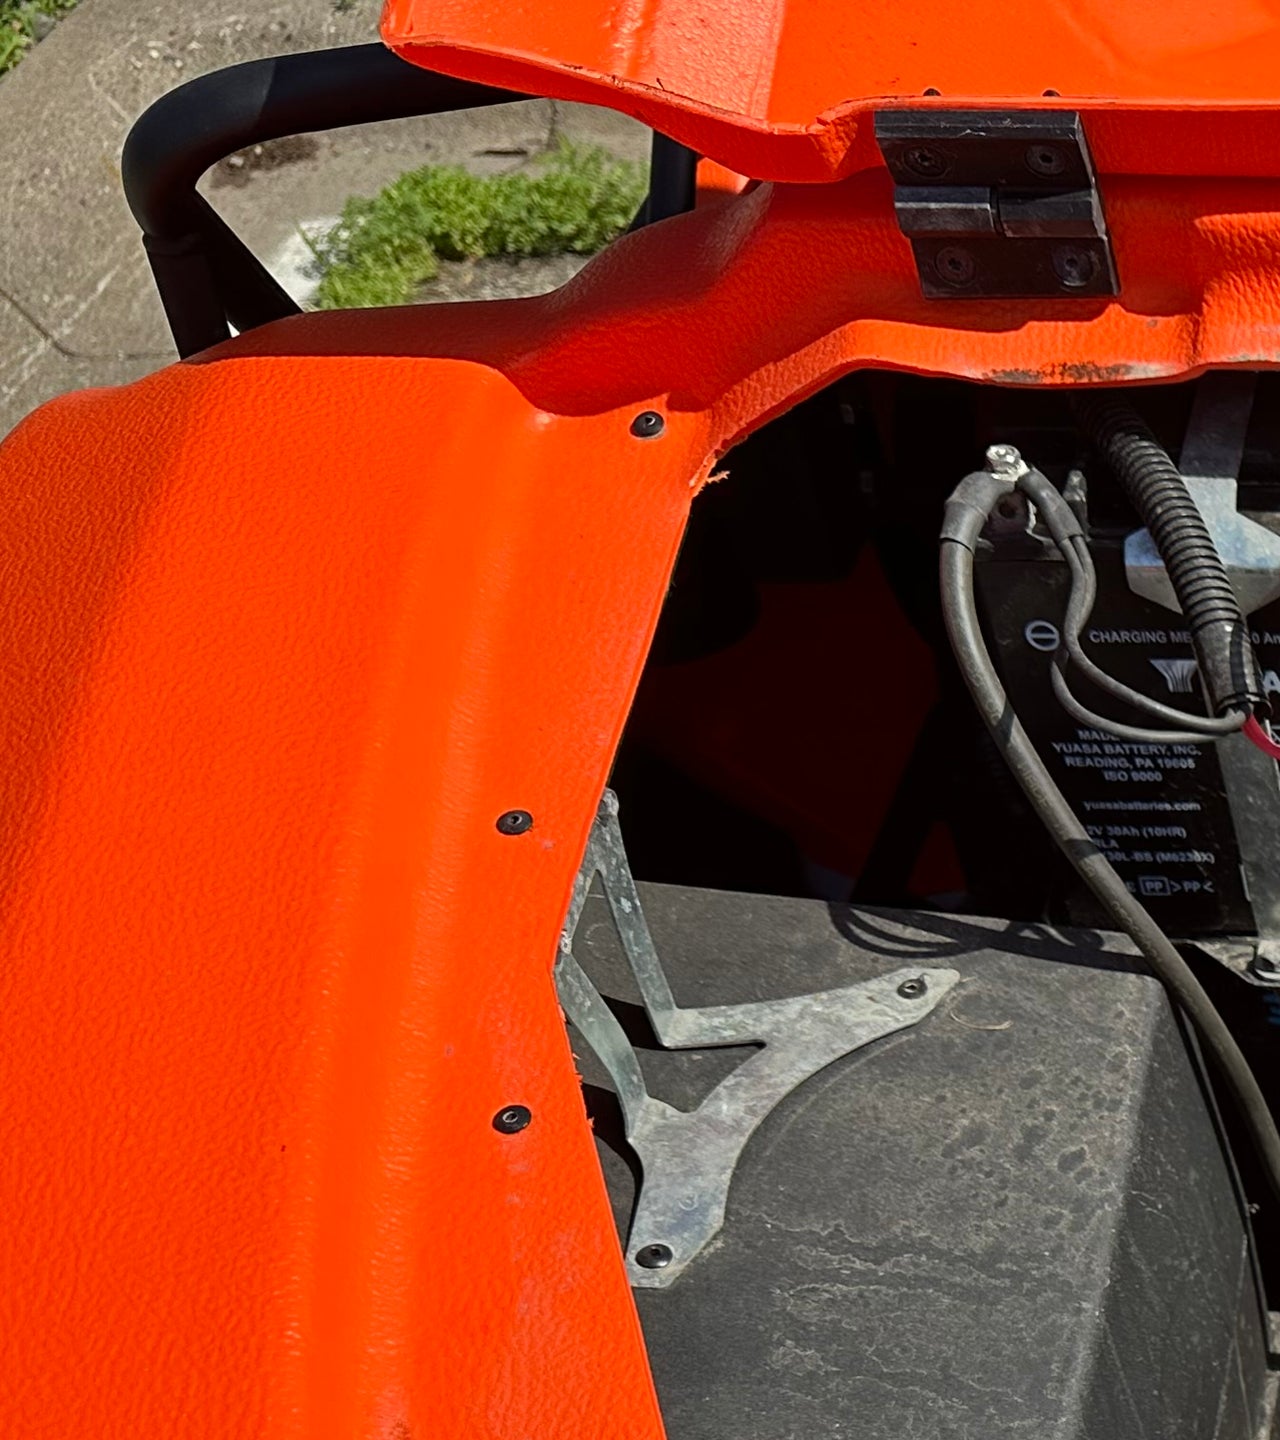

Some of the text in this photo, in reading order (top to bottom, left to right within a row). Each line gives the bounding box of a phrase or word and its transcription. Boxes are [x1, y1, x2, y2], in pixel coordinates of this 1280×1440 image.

[1089, 630, 1166, 643] CHARGING
[1052, 743, 1102, 754] YUASA
[1065, 757, 1133, 769] READING,
[1135, 757, 1153, 768] PA
[1104, 770, 1128, 781] ISO
[1084, 801, 1201, 811] yuasabatteries.com
[1143, 826, 1186, 838] (10HR)
[1145, 882, 1163, 893] PP
